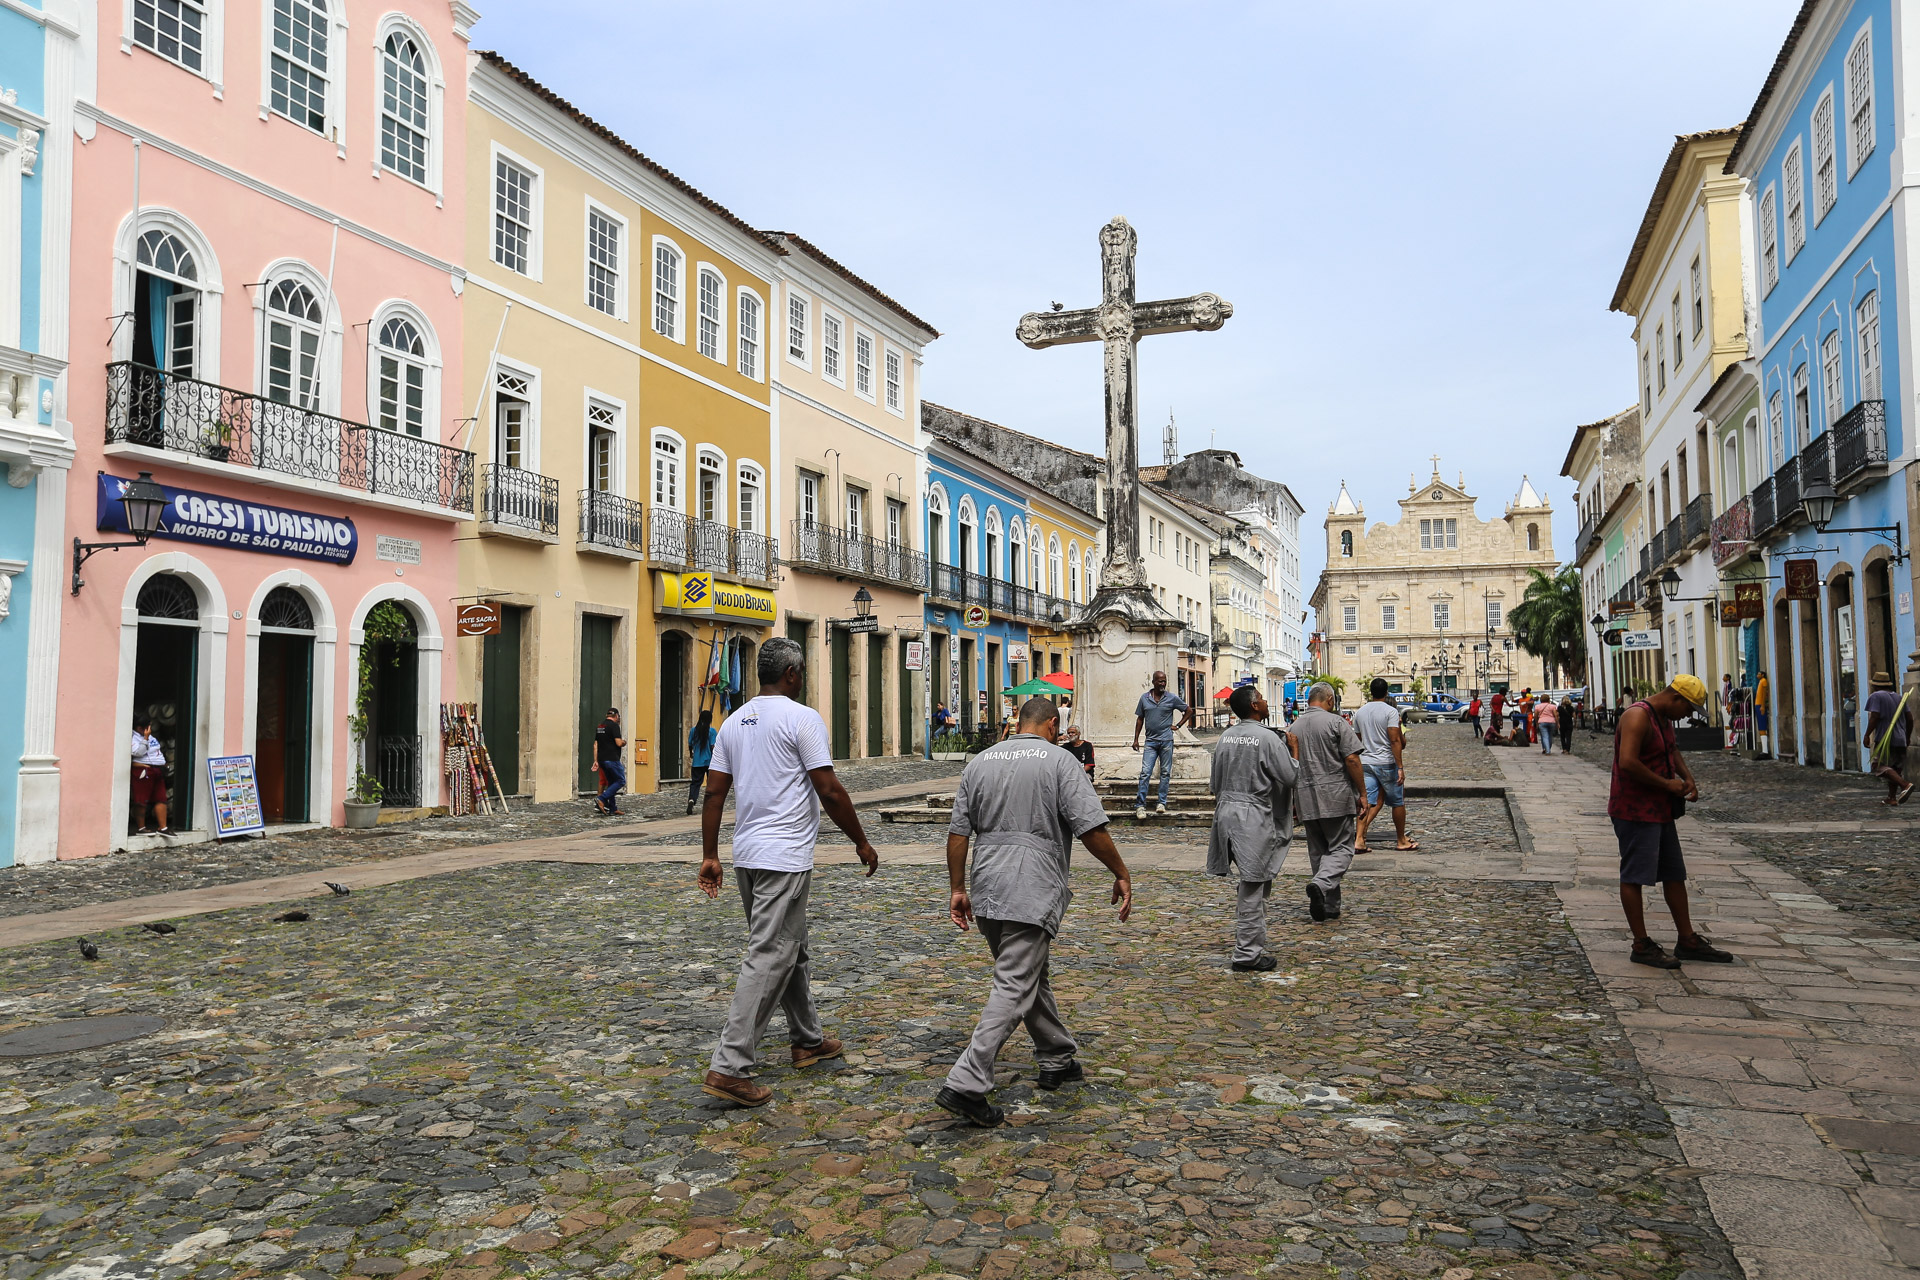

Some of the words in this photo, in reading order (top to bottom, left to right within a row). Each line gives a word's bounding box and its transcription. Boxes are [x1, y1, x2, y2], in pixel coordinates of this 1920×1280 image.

[174, 494, 245, 529] CASSI
[248, 506, 351, 546] TURISMO
[172, 523, 227, 541] MORRO
[230, 531, 248, 544] DE
[252, 534, 280, 549] SÃO
[282, 540, 324, 555] PAULO
[385, 538, 413, 547] SOCIEDADE
[715, 591, 732, 607] NCO
[733, 594, 745, 608] DO
[745, 593, 773, 613] BRASIL
[475, 615, 497, 623] SACRA
[1222, 735, 1260, 746] MANUTENÇÃO
[984, 747, 1048, 761] MANUTENÇÃO
